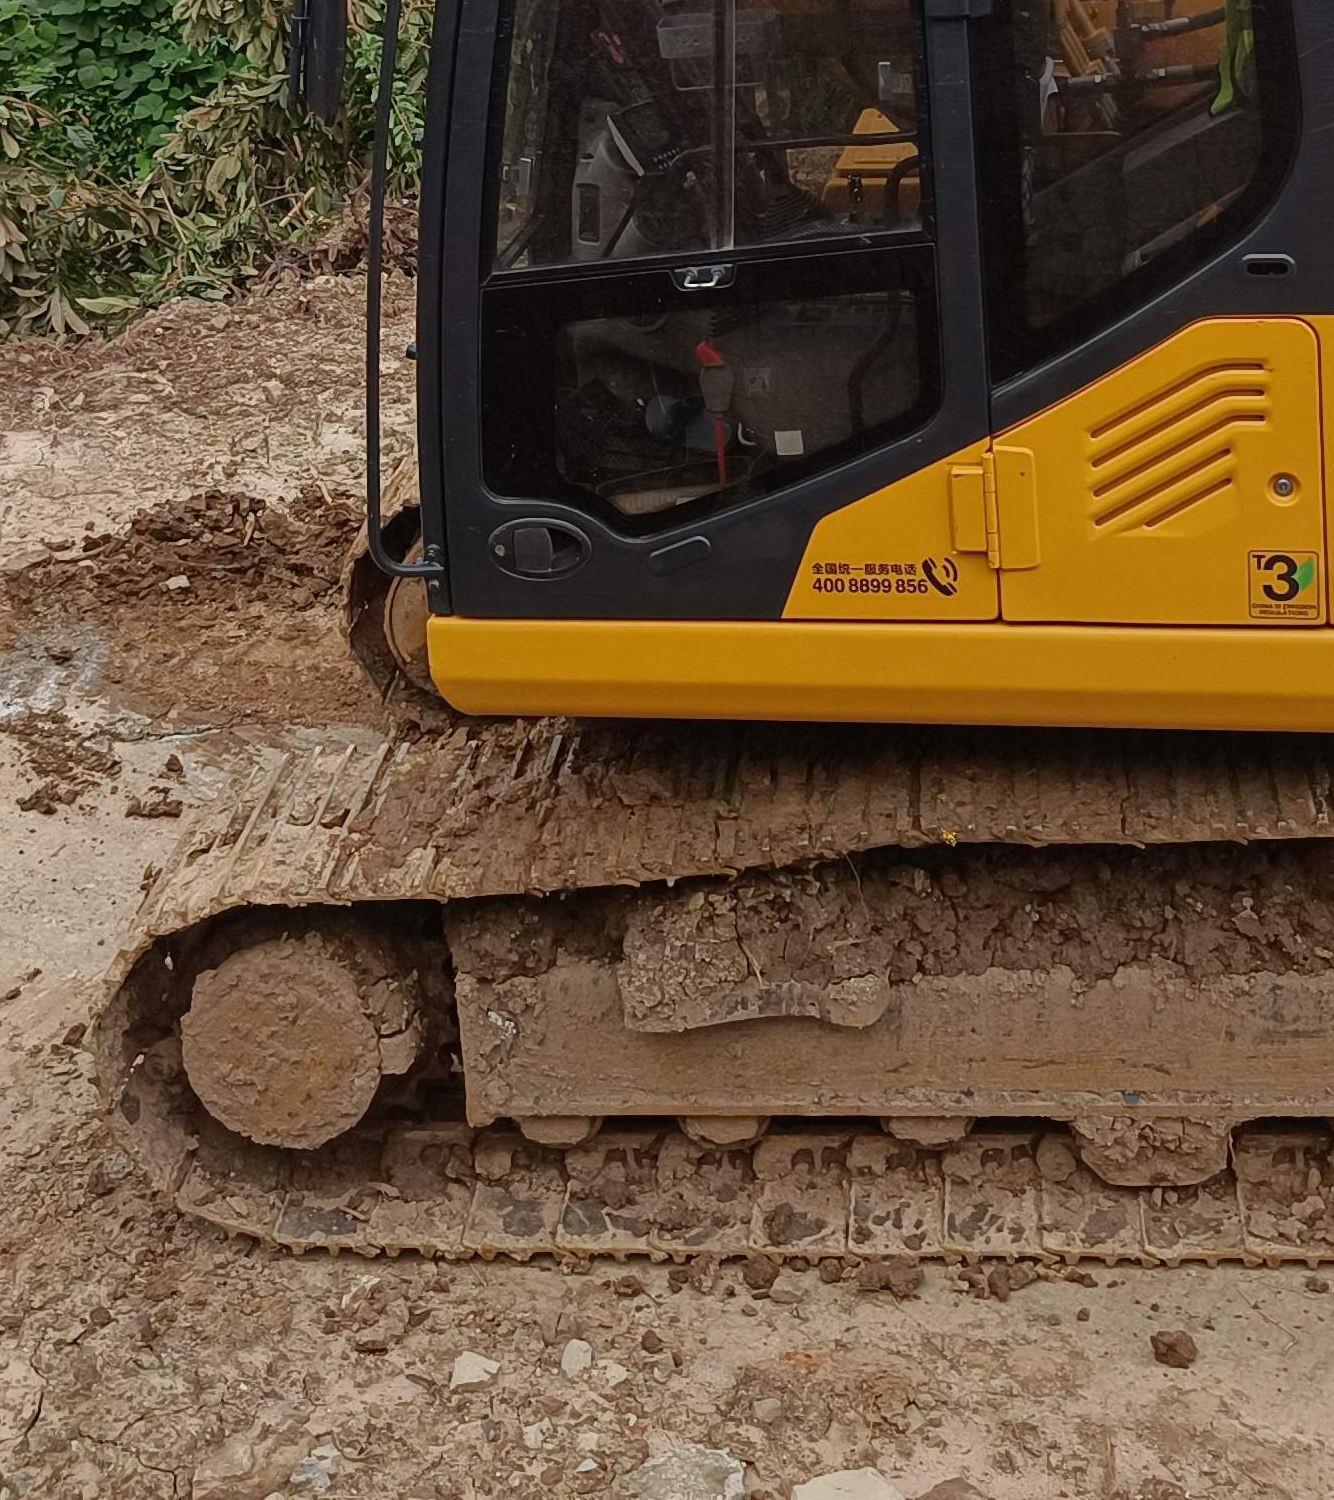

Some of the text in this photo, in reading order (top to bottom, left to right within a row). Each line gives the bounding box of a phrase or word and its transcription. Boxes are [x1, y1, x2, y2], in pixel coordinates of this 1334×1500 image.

[811, 562, 917, 576] 全国统一服务电话
[812, 577, 929, 594] 400 8899 856
